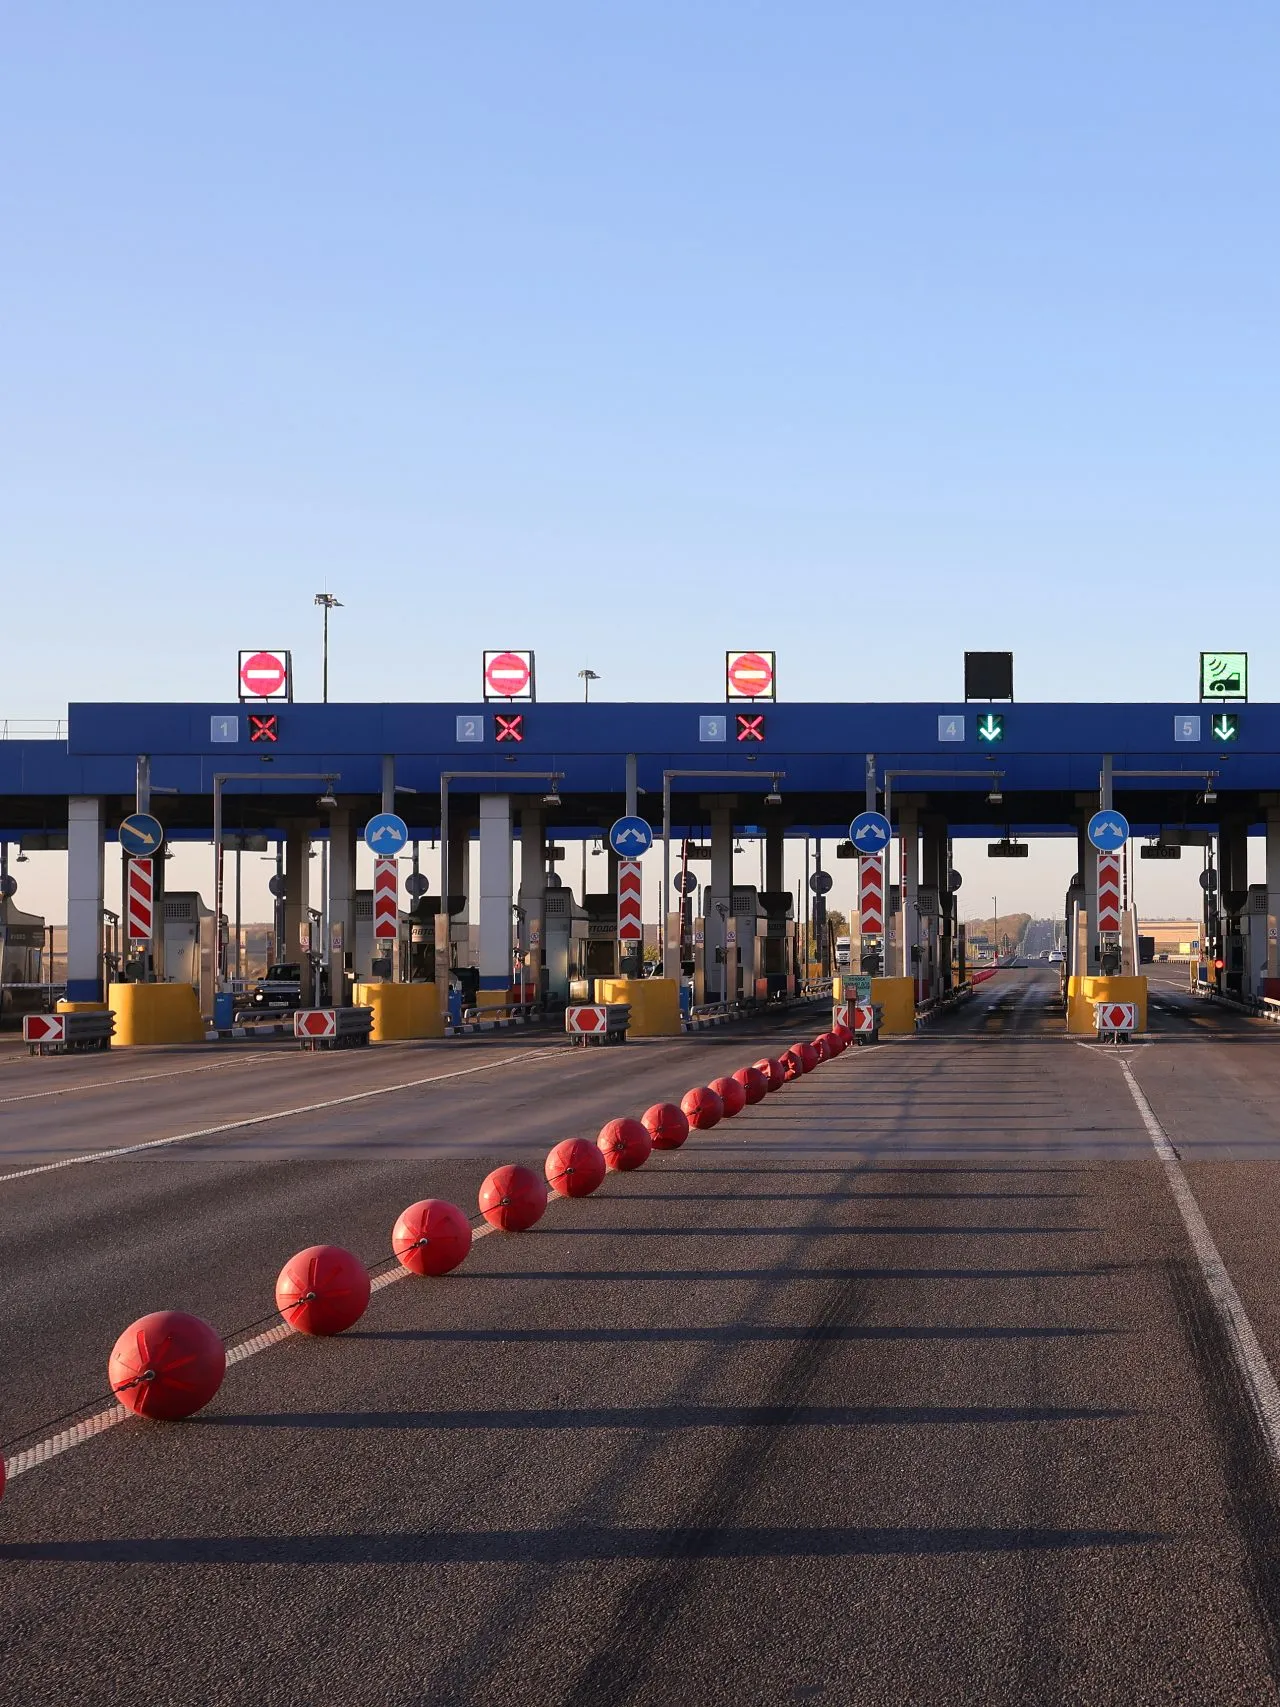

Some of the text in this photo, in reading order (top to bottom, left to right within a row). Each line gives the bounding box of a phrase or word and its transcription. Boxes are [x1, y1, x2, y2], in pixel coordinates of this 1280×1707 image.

[220, 722, 229, 736] 1
[465, 722, 475, 736] 2
[708, 722, 718, 736] 3
[945, 722, 956, 736] 4
[1182, 722, 1192, 736] 5
[994, 846, 1022, 855] СТОП
[1147, 848, 1175, 857] СТОП
